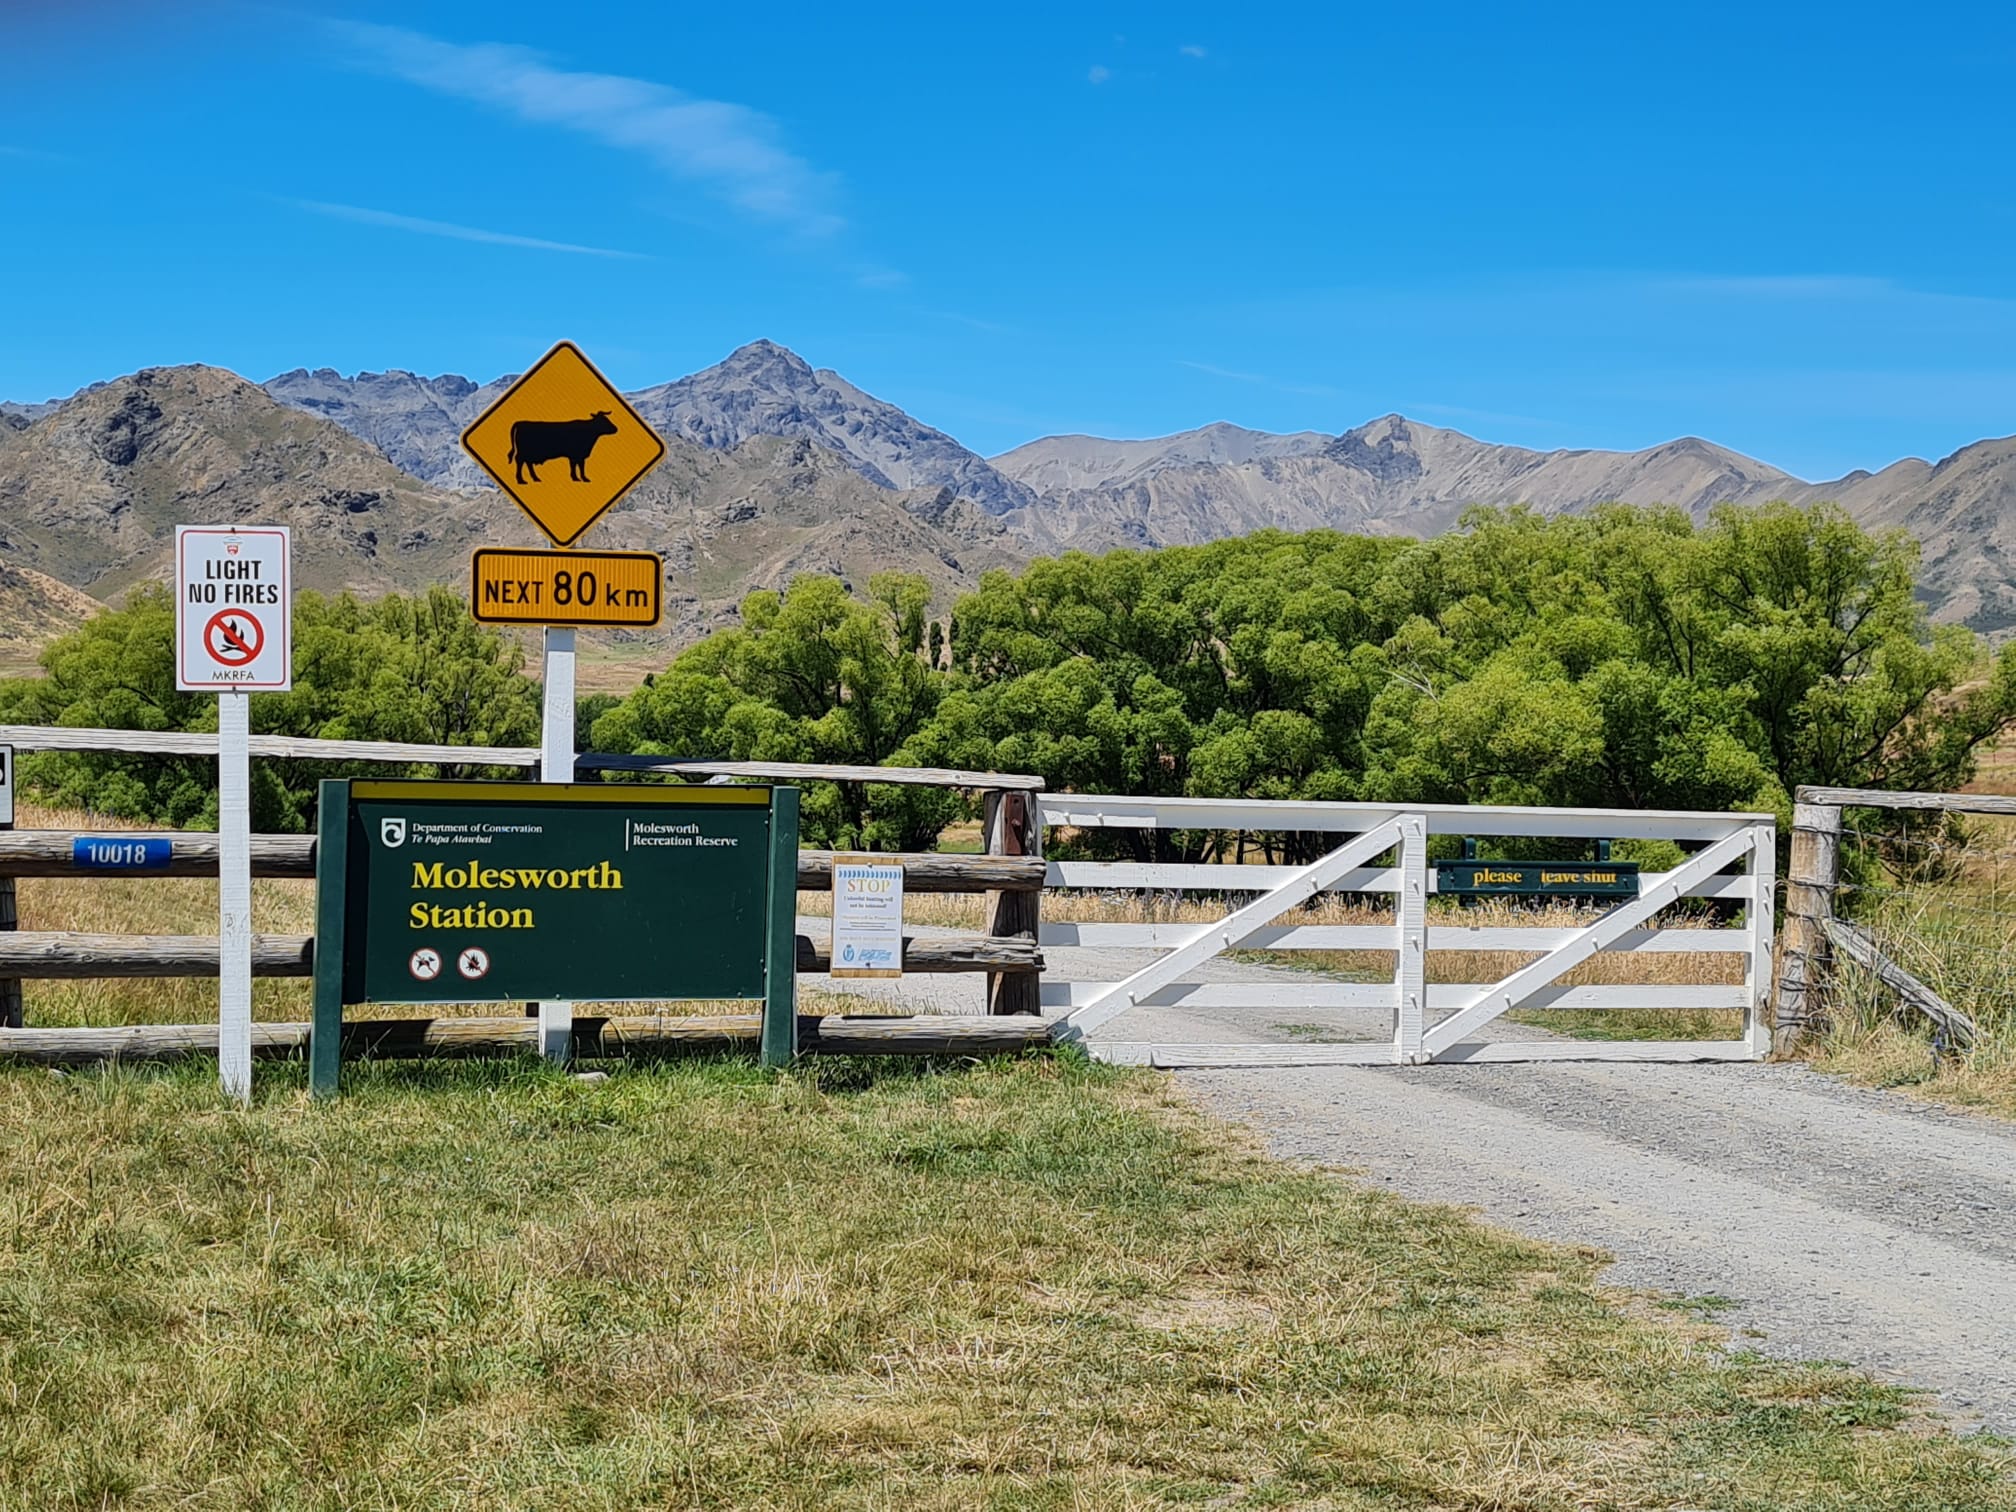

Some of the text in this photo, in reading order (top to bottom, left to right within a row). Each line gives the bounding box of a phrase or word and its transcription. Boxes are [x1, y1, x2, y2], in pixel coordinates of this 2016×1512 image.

[206, 559, 262, 580] LIGHT
[189, 583, 278, 604] NO FIRES
[485, 570, 648, 607] NEXT 80 km
[211, 670, 255, 681] MKRFA
[412, 823, 543, 834] Department of Conservation
[633, 822, 699, 834] Molesworth
[411, 834, 423, 844] Te
[425, 834, 450, 846] Papa
[633, 835, 739, 847] Recreation Reserve
[87, 842, 147, 865] 10018
[411, 860, 624, 889] Molesworth
[1473, 868, 1522, 887] please
[848, 879, 890, 892] STOP
[409, 901, 535, 929] Station
